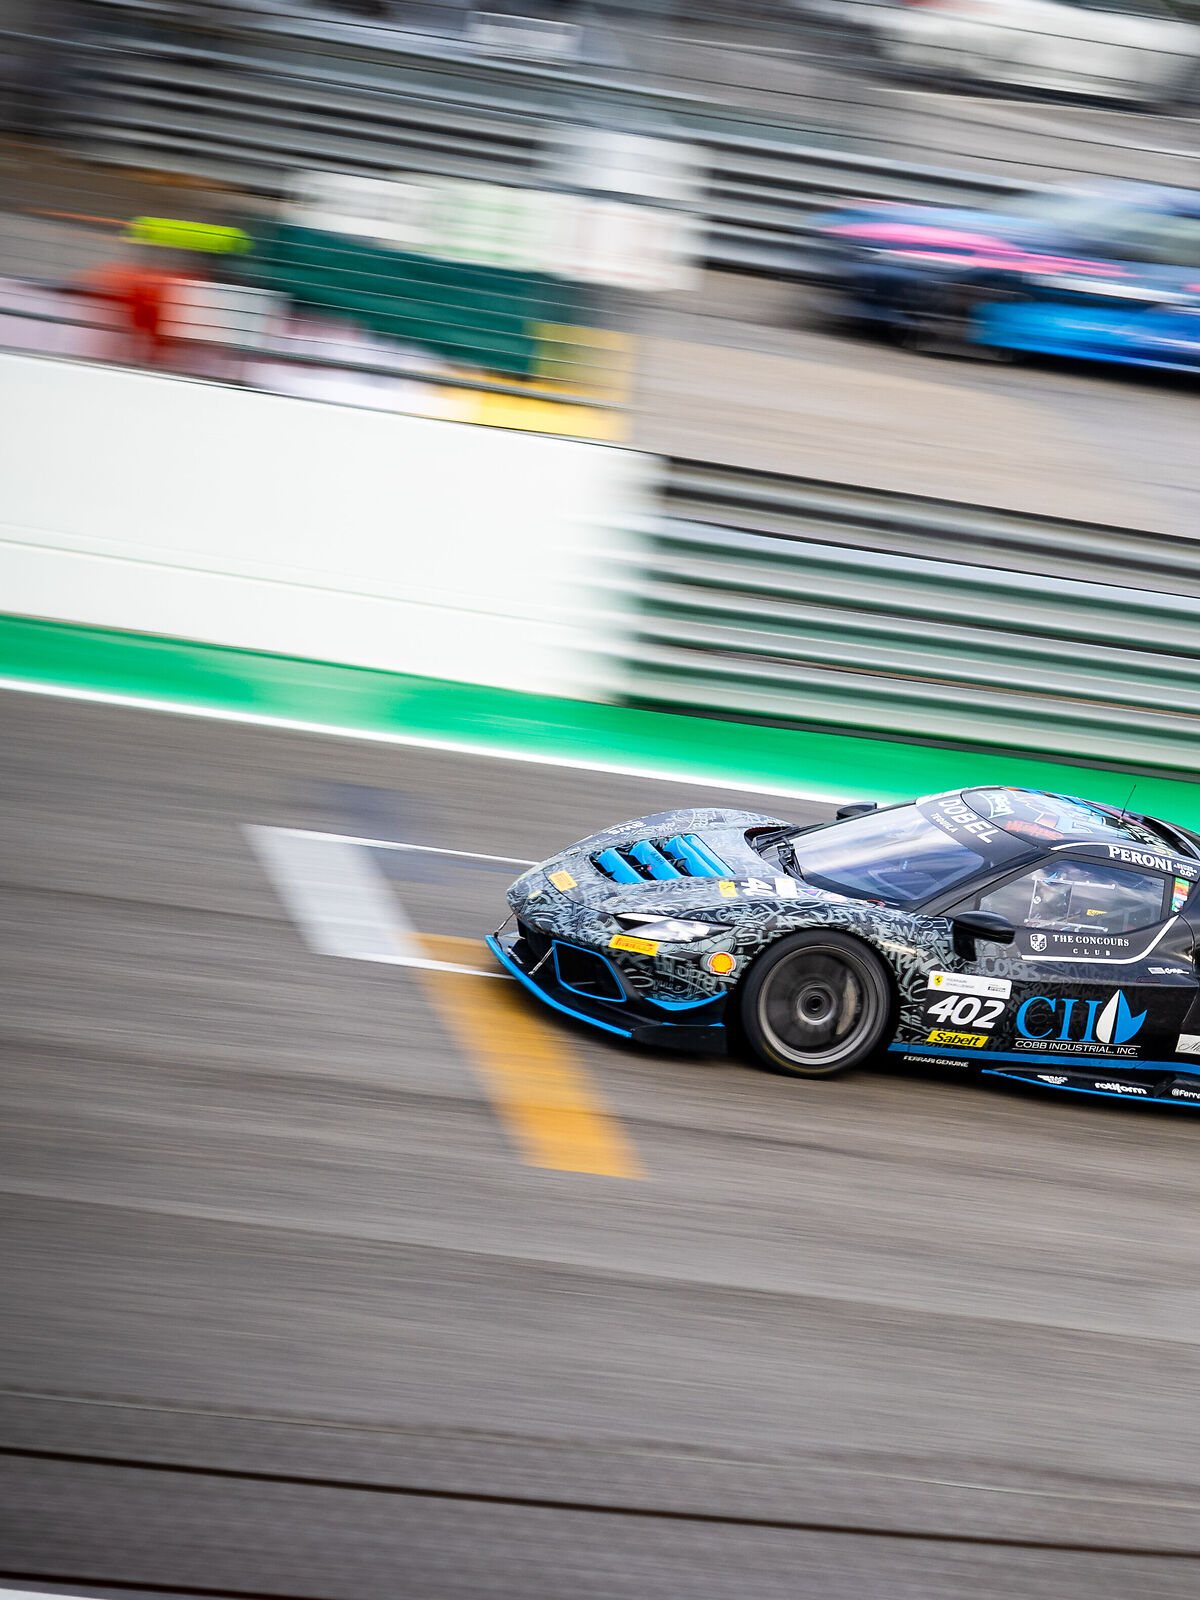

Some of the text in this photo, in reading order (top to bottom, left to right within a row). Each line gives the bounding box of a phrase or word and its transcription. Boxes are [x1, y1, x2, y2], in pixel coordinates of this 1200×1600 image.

[938, 800, 998, 844] DOBEL
[1108, 845, 1173, 872] PERONI
[1053, 935, 1130, 947] THE CONCOURS
[1073, 948, 1111, 956] CLUB
[927, 995, 1006, 1029] 402
[1016, 996, 1103, 1043] CII
[933, 1032, 983, 1046] Sabelt
[1015, 1041, 1047, 1050] COBB
[1116, 1046, 1138, 1055] INC.
[903, 1055, 969, 1067] FERRARI GENUINE
[1094, 1082, 1147, 1095] rotiform
